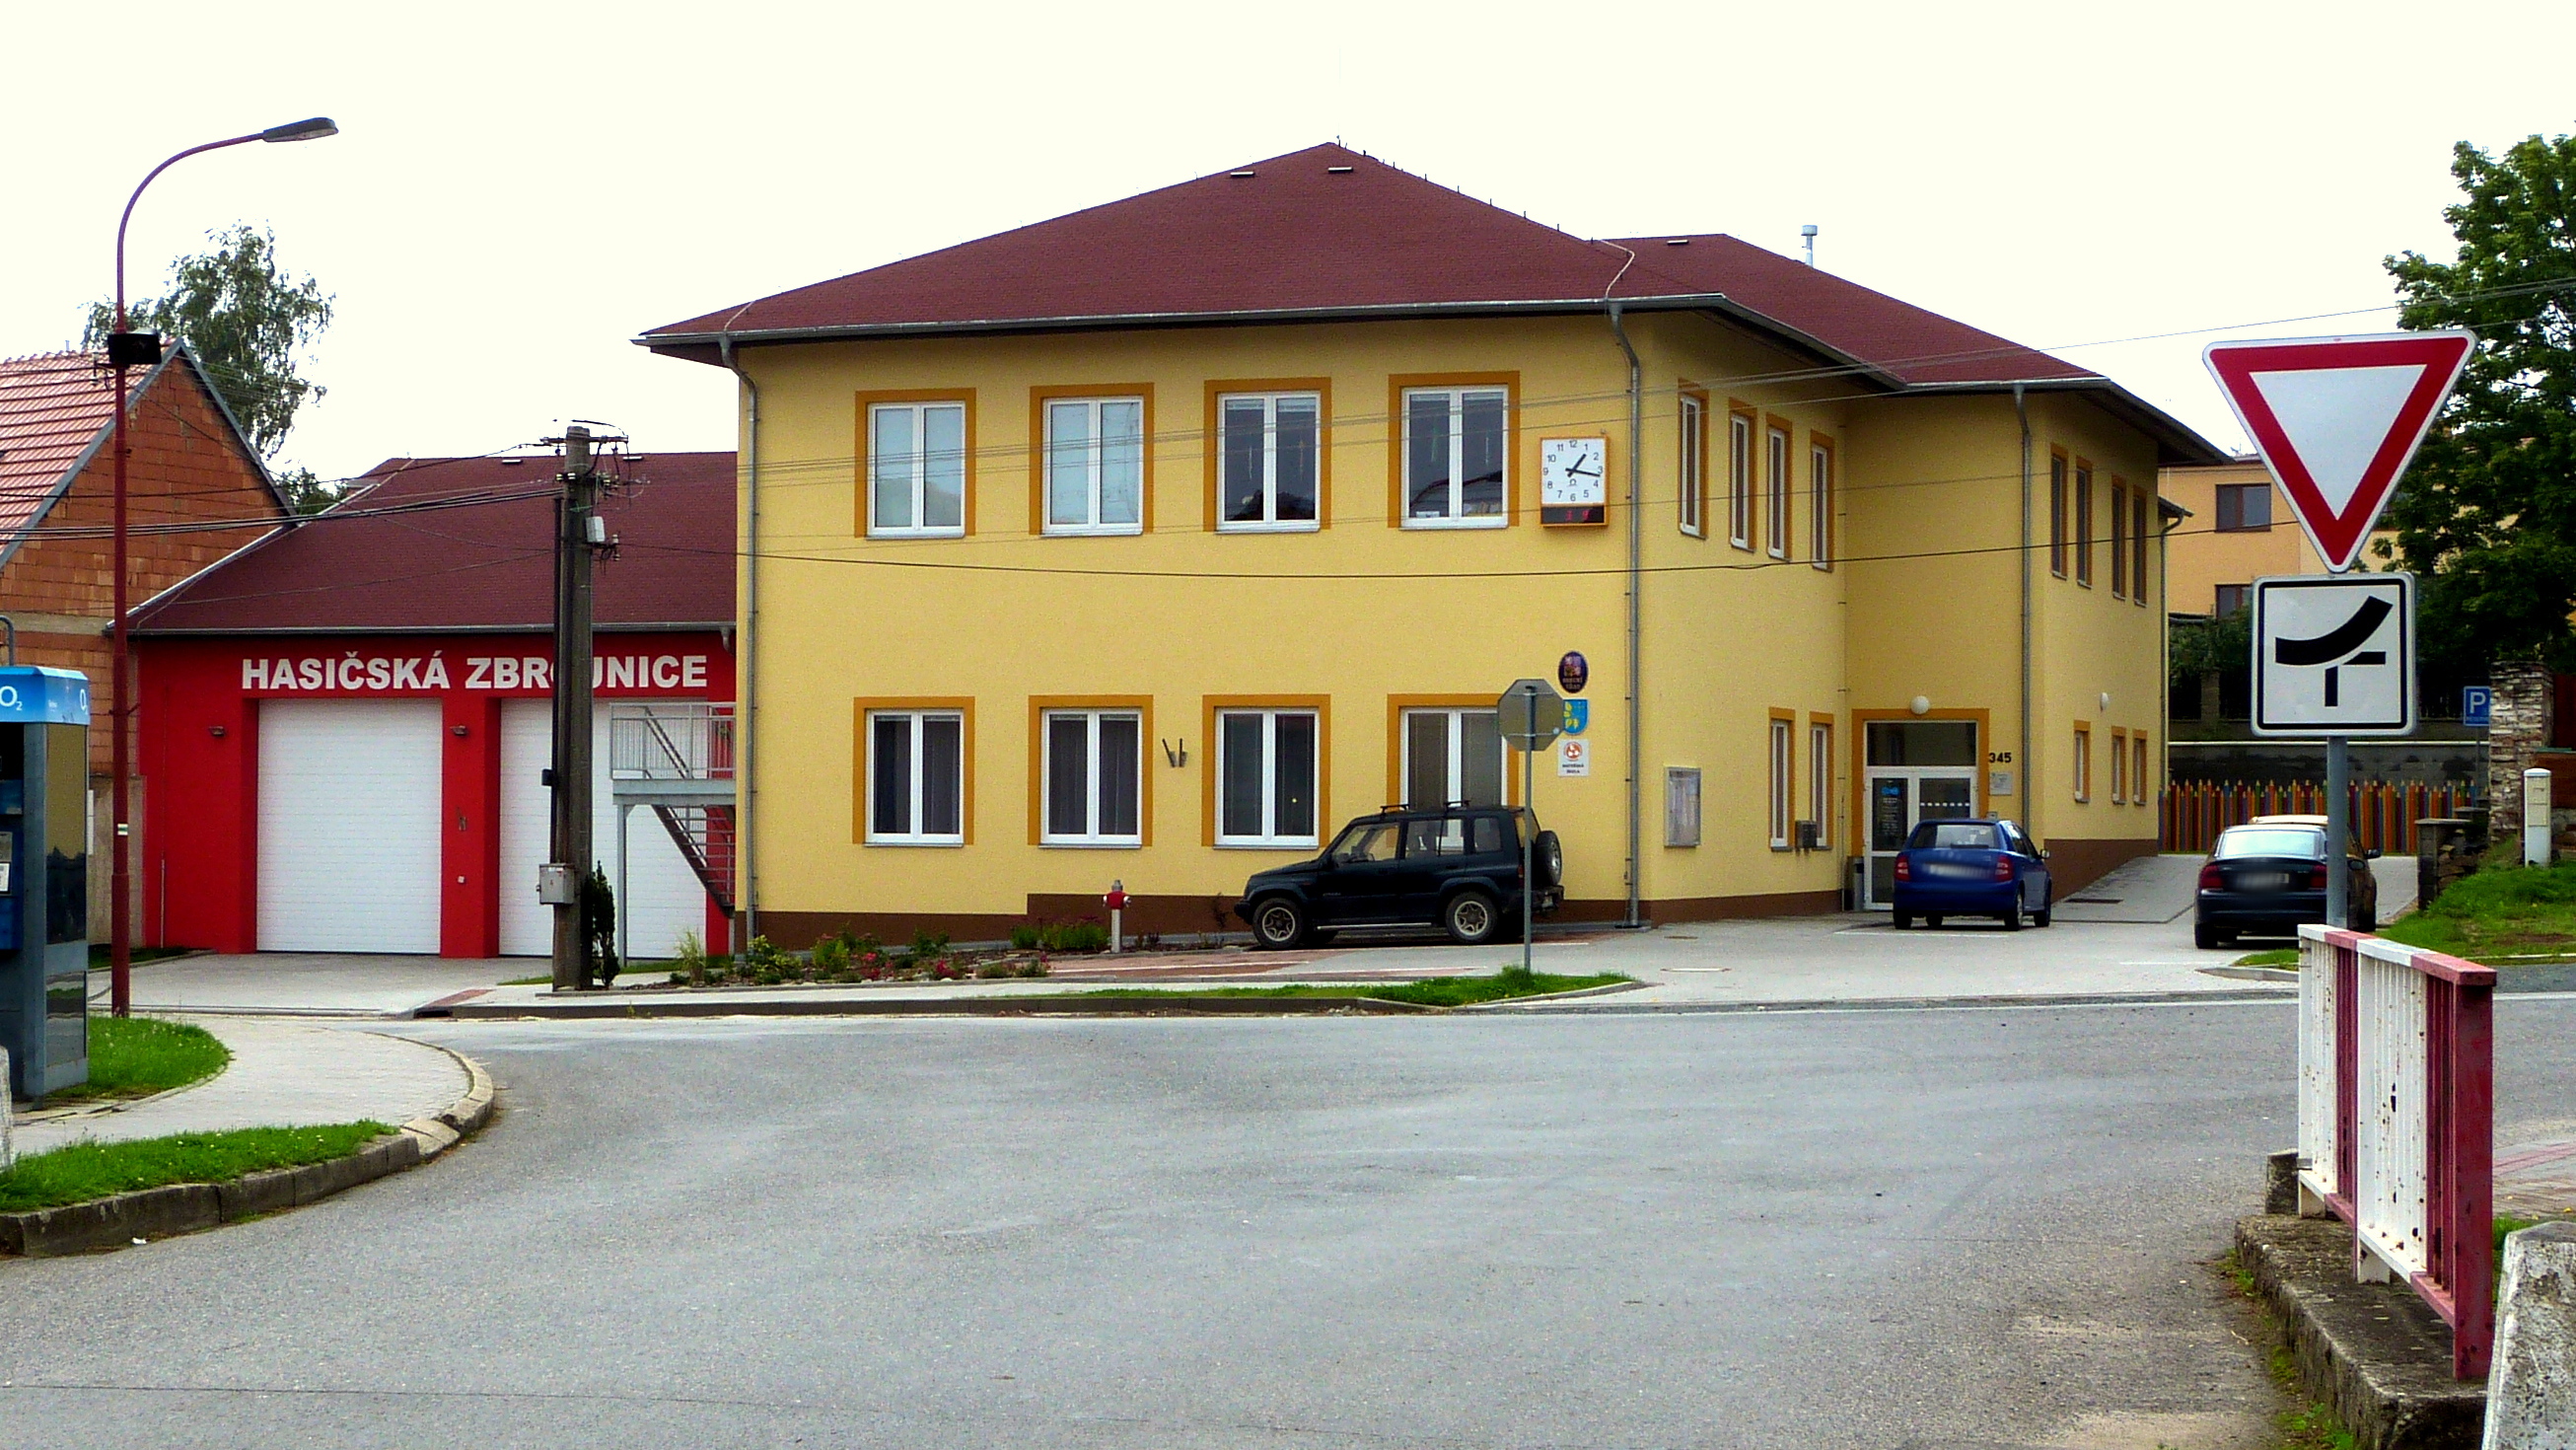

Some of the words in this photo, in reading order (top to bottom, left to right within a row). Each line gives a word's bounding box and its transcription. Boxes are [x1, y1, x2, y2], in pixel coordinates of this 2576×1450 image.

[1547, 480, 1552, 489] 8
[242, 650, 450, 689] HASIČSKÁ
[465, 655, 708, 689] ZBRJNICE
[0, 686, 23, 710] O2
[2469, 691, 2485, 713] P
[1988, 752, 2012, 763] 345
